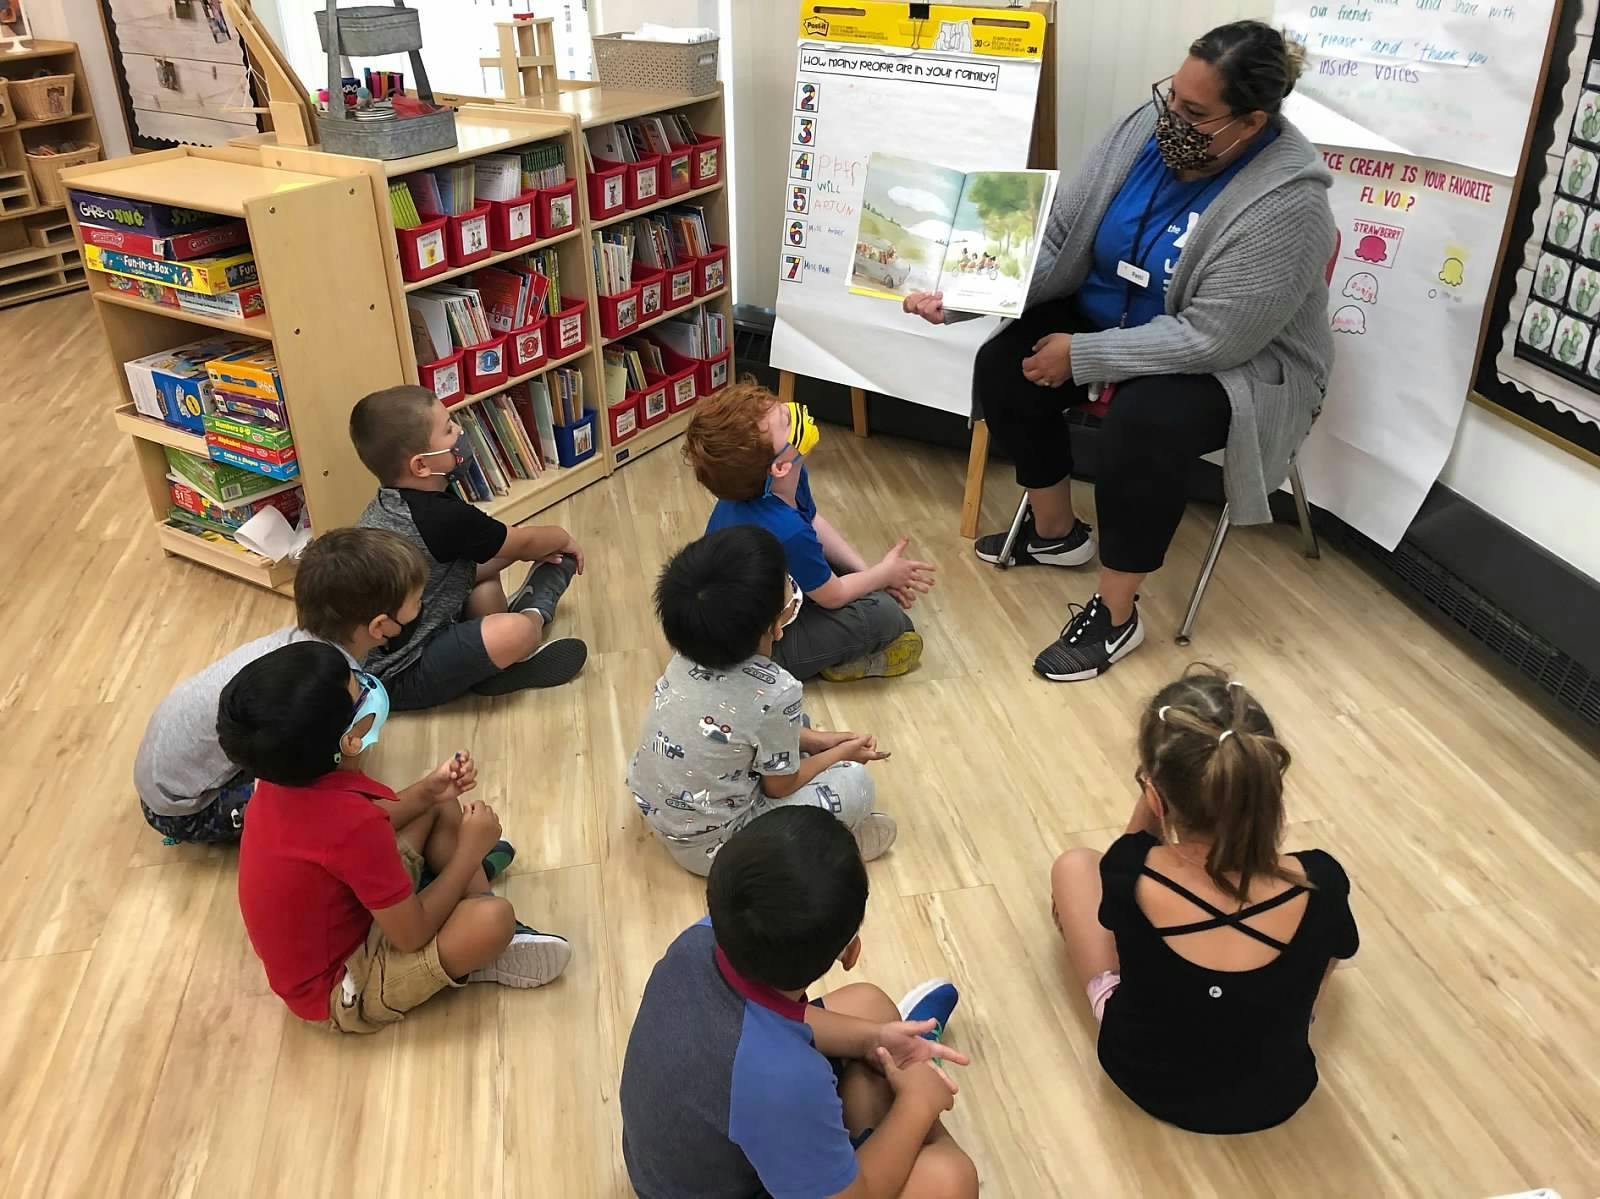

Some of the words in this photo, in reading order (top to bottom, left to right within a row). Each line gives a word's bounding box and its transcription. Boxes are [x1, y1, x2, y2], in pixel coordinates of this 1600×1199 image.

[1488, 6, 1516, 20] with
[807, 21, 826, 31] Post-it
[1026, 46, 1038, 54] 3M
[1371, 39, 1402, 56] and
[829, 58, 858, 70] many
[860, 60, 893, 73] people
[896, 63, 912, 74] are
[915, 65, 923, 75] in
[926, 66, 952, 78] your
[955, 69, 996, 84] family?
[1375, 64, 1419, 83] voices
[801, 84, 815, 110] 2
[797, 119, 812, 144] 3
[795, 152, 810, 178] 4
[1349, 157, 1394, 179] CREAM
[1400, 165, 1418, 183] IS
[1423, 168, 1447, 192] YOUR
[1448, 175, 1493, 203] FAVORITE
[792, 187, 807, 212] 5
[790, 221, 803, 245] 6
[1167, 225, 1181, 234] the
[1353, 222, 1401, 240] STRAWBERRY
[786, 256, 800, 279] 7
